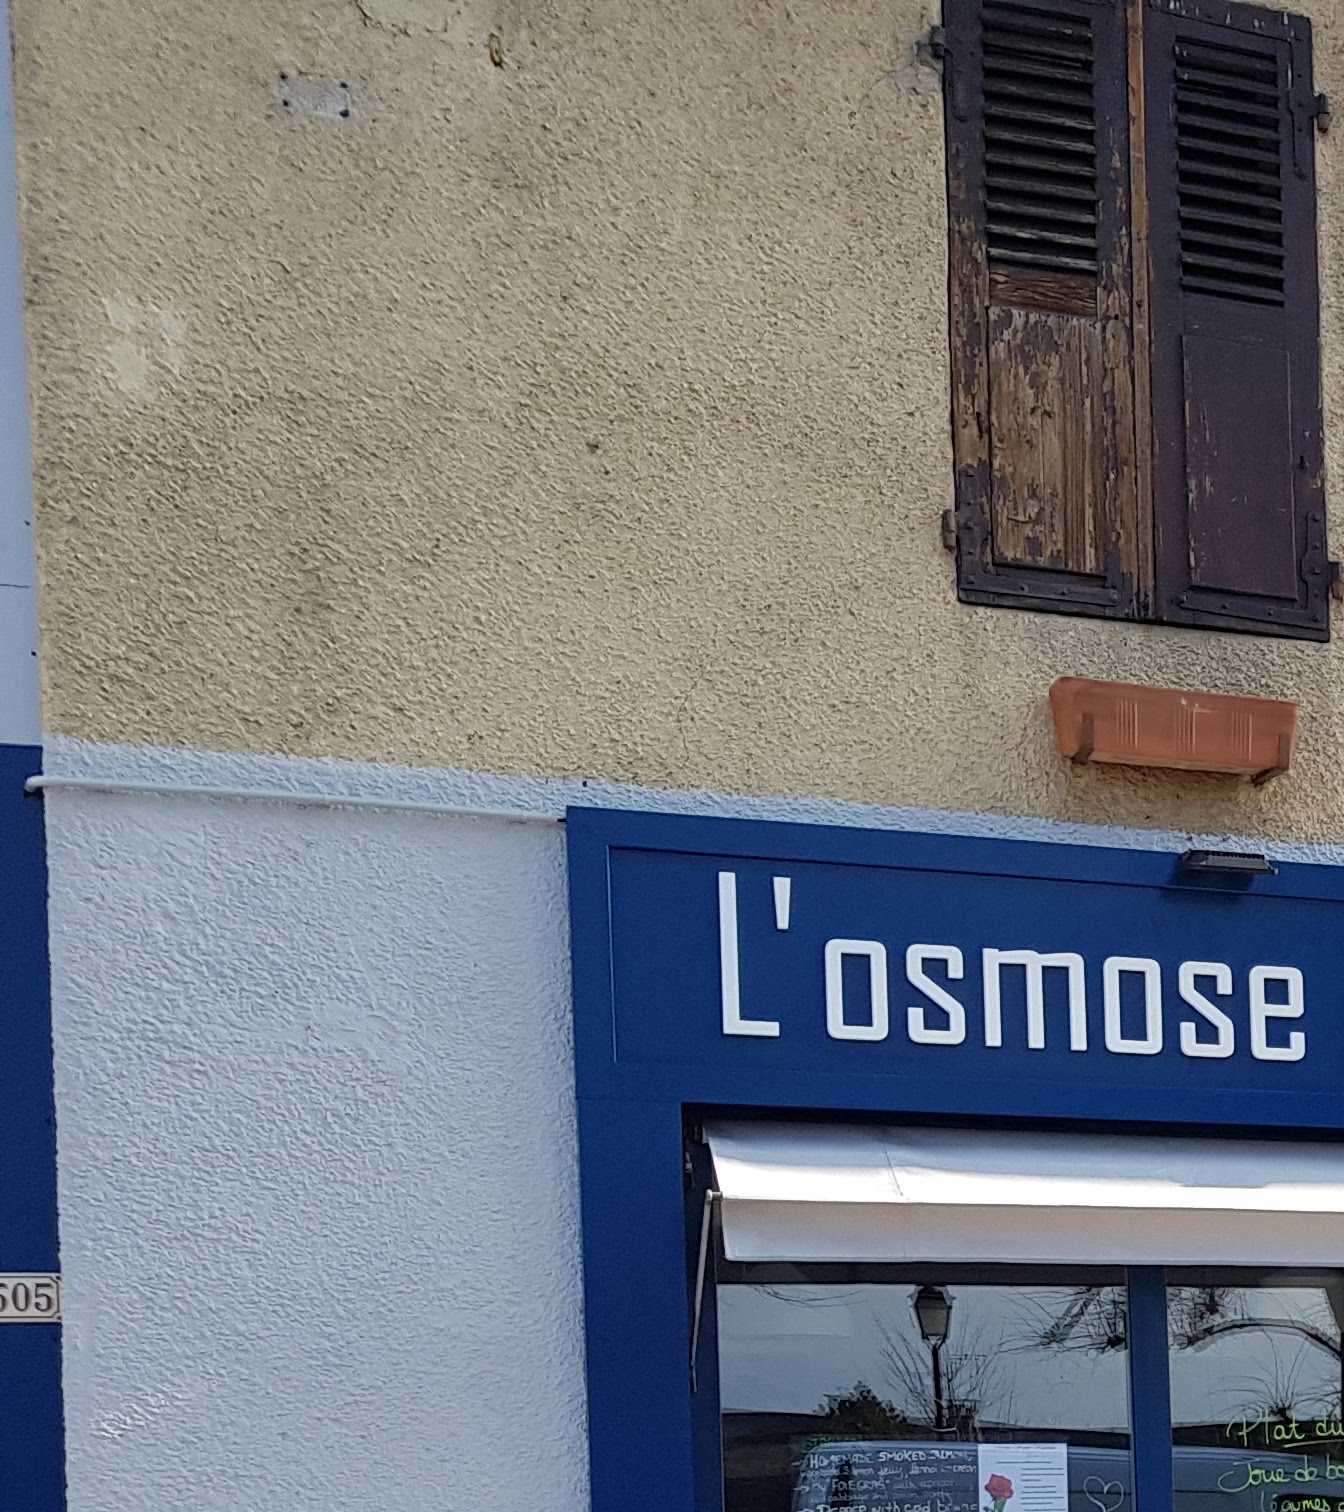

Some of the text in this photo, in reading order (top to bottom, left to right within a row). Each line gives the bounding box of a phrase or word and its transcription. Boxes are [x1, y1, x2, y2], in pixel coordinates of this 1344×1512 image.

[719, 870, 1306, 1062] L'osmose
[1226, 1408, 1305, 1447] Plat
[877, 1449, 926, 1462] SMOKED
[1218, 1458, 1290, 1493] Joue
[1294, 1454, 1322, 1482] de
